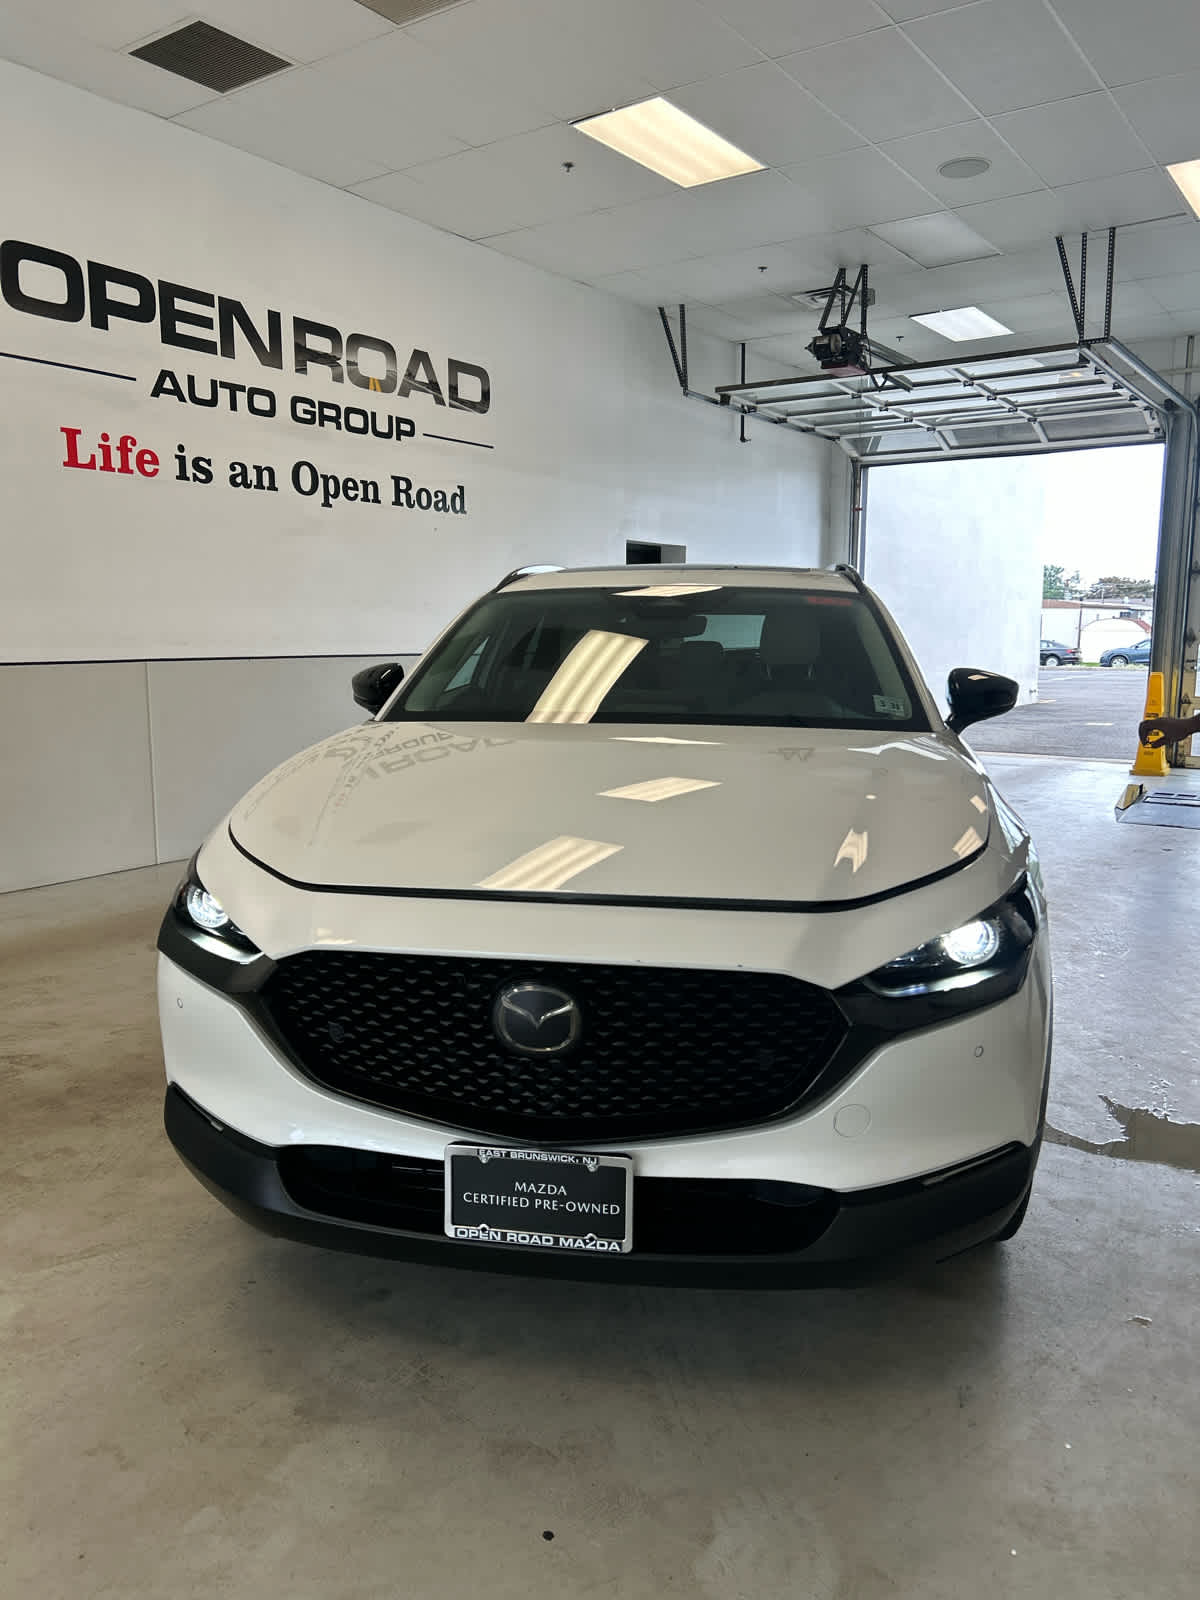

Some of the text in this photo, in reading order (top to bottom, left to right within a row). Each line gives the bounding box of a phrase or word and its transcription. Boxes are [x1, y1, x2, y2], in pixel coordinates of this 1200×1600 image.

[0, 240, 490, 414] OPEN ROAD
[151, 369, 415, 441] AUTO GROUP
[60, 427, 466, 514] Life is an Open Road
[479, 1149, 598, 1165] EAST BRUNSWICK, NJ
[514, 1181, 567, 1196] MAZDA
[463, 1192, 621, 1215] CERTIFIED PRE-OWNED
[456, 1228, 621, 1252] OPEN ROAD MAZDA
